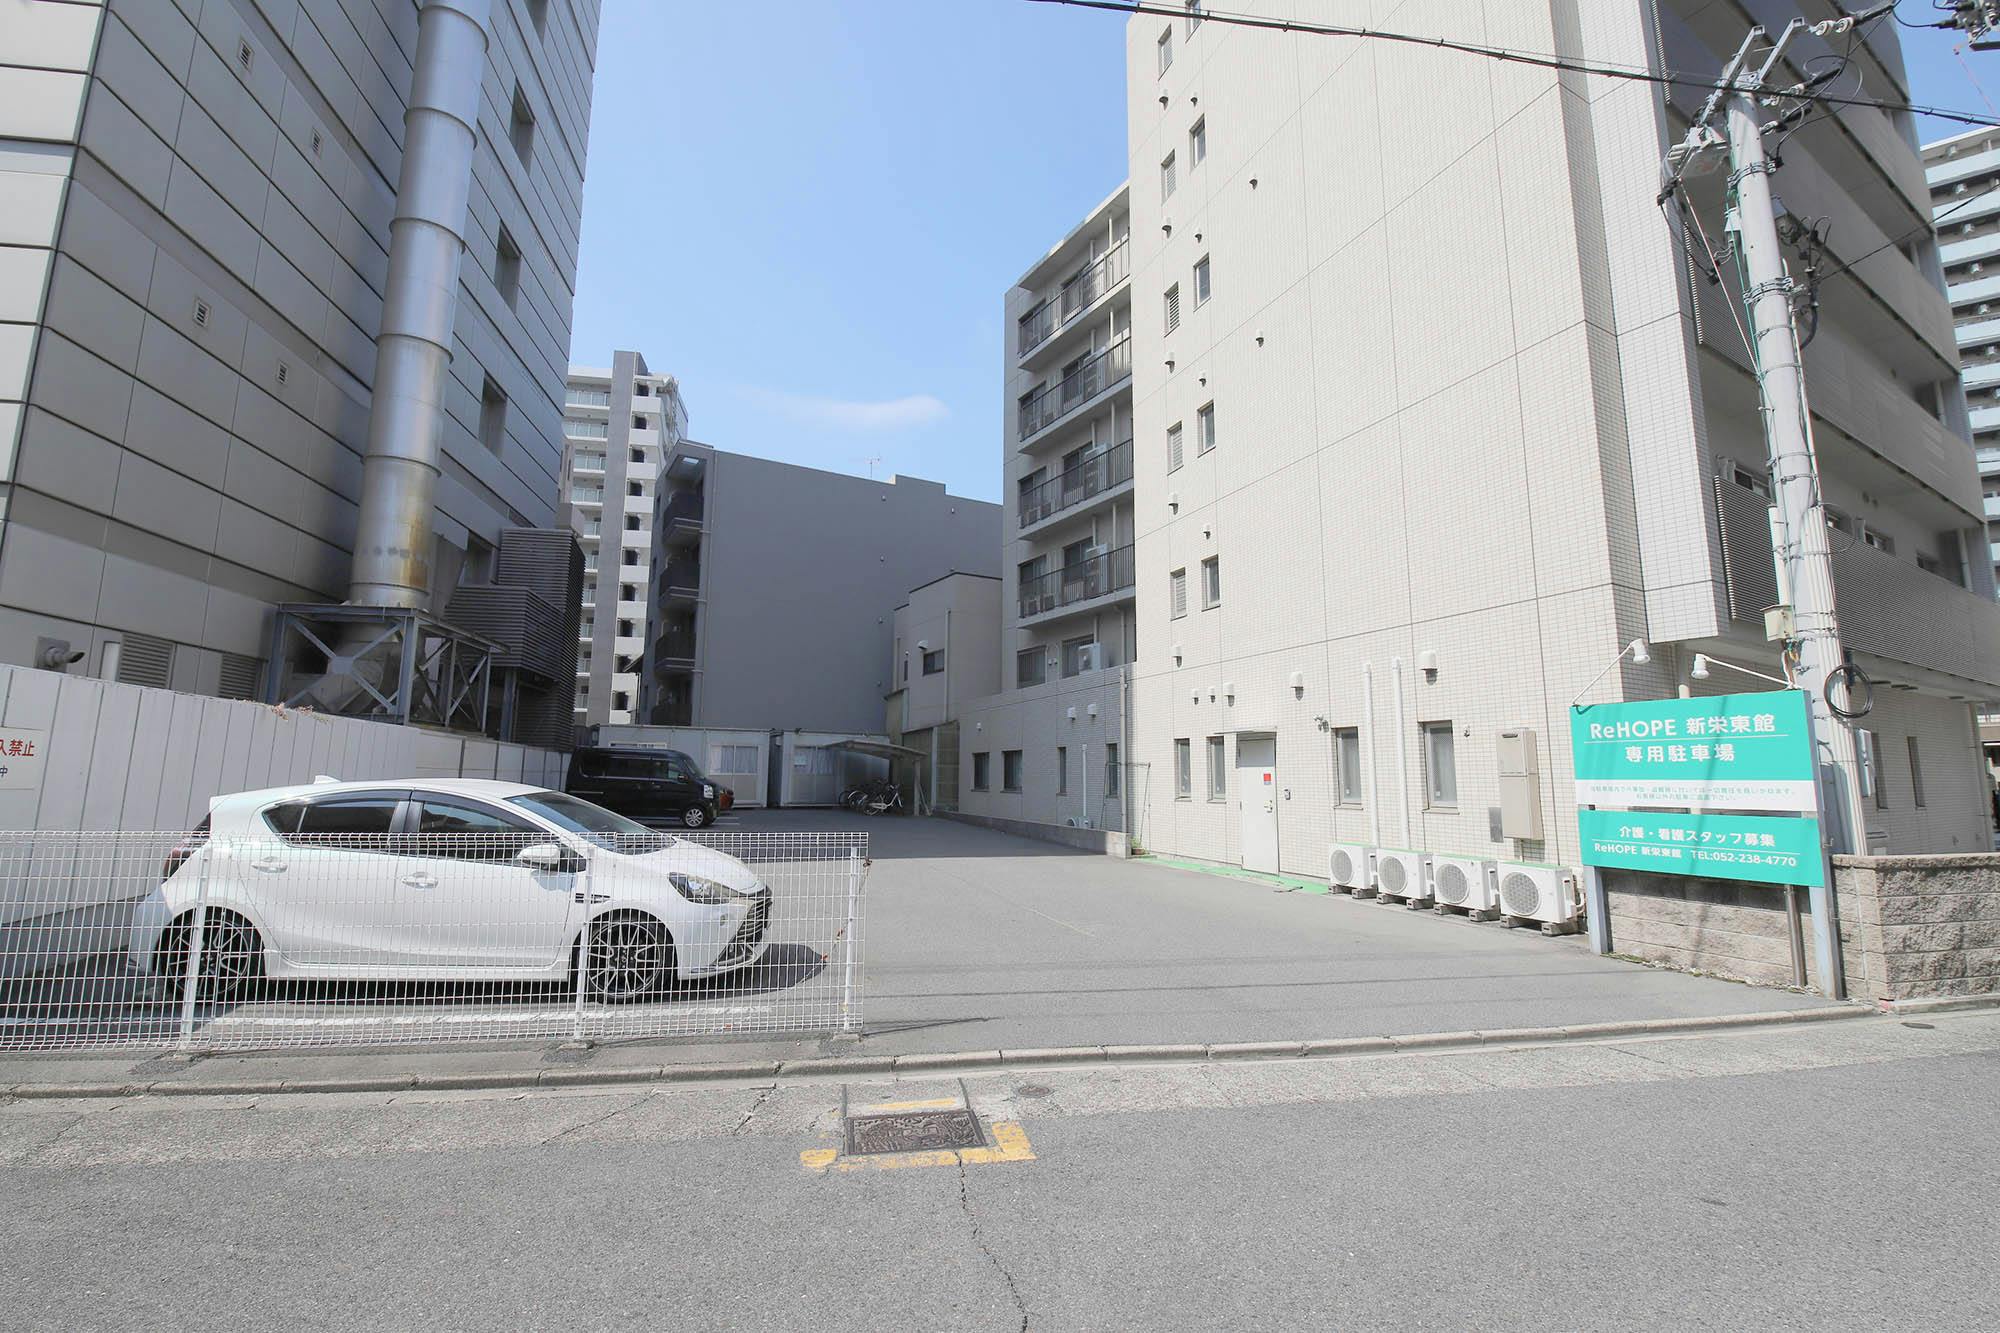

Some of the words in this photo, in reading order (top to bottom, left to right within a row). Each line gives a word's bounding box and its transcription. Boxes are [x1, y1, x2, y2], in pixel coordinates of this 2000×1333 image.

[1590, 718, 1677, 740] ReHOPE
[1686, 713, 1776, 736] 新栄東館
[1625, 743, 1736, 763] 専用駐車場
[1619, 825, 1776, 847] 介護・看護スタッフ募集
[1594, 842, 1637, 855] ReHOPE
[1641, 846, 1682, 859] 新栄東館
[1690, 849, 1797, 867] TEL:052-238-4770
